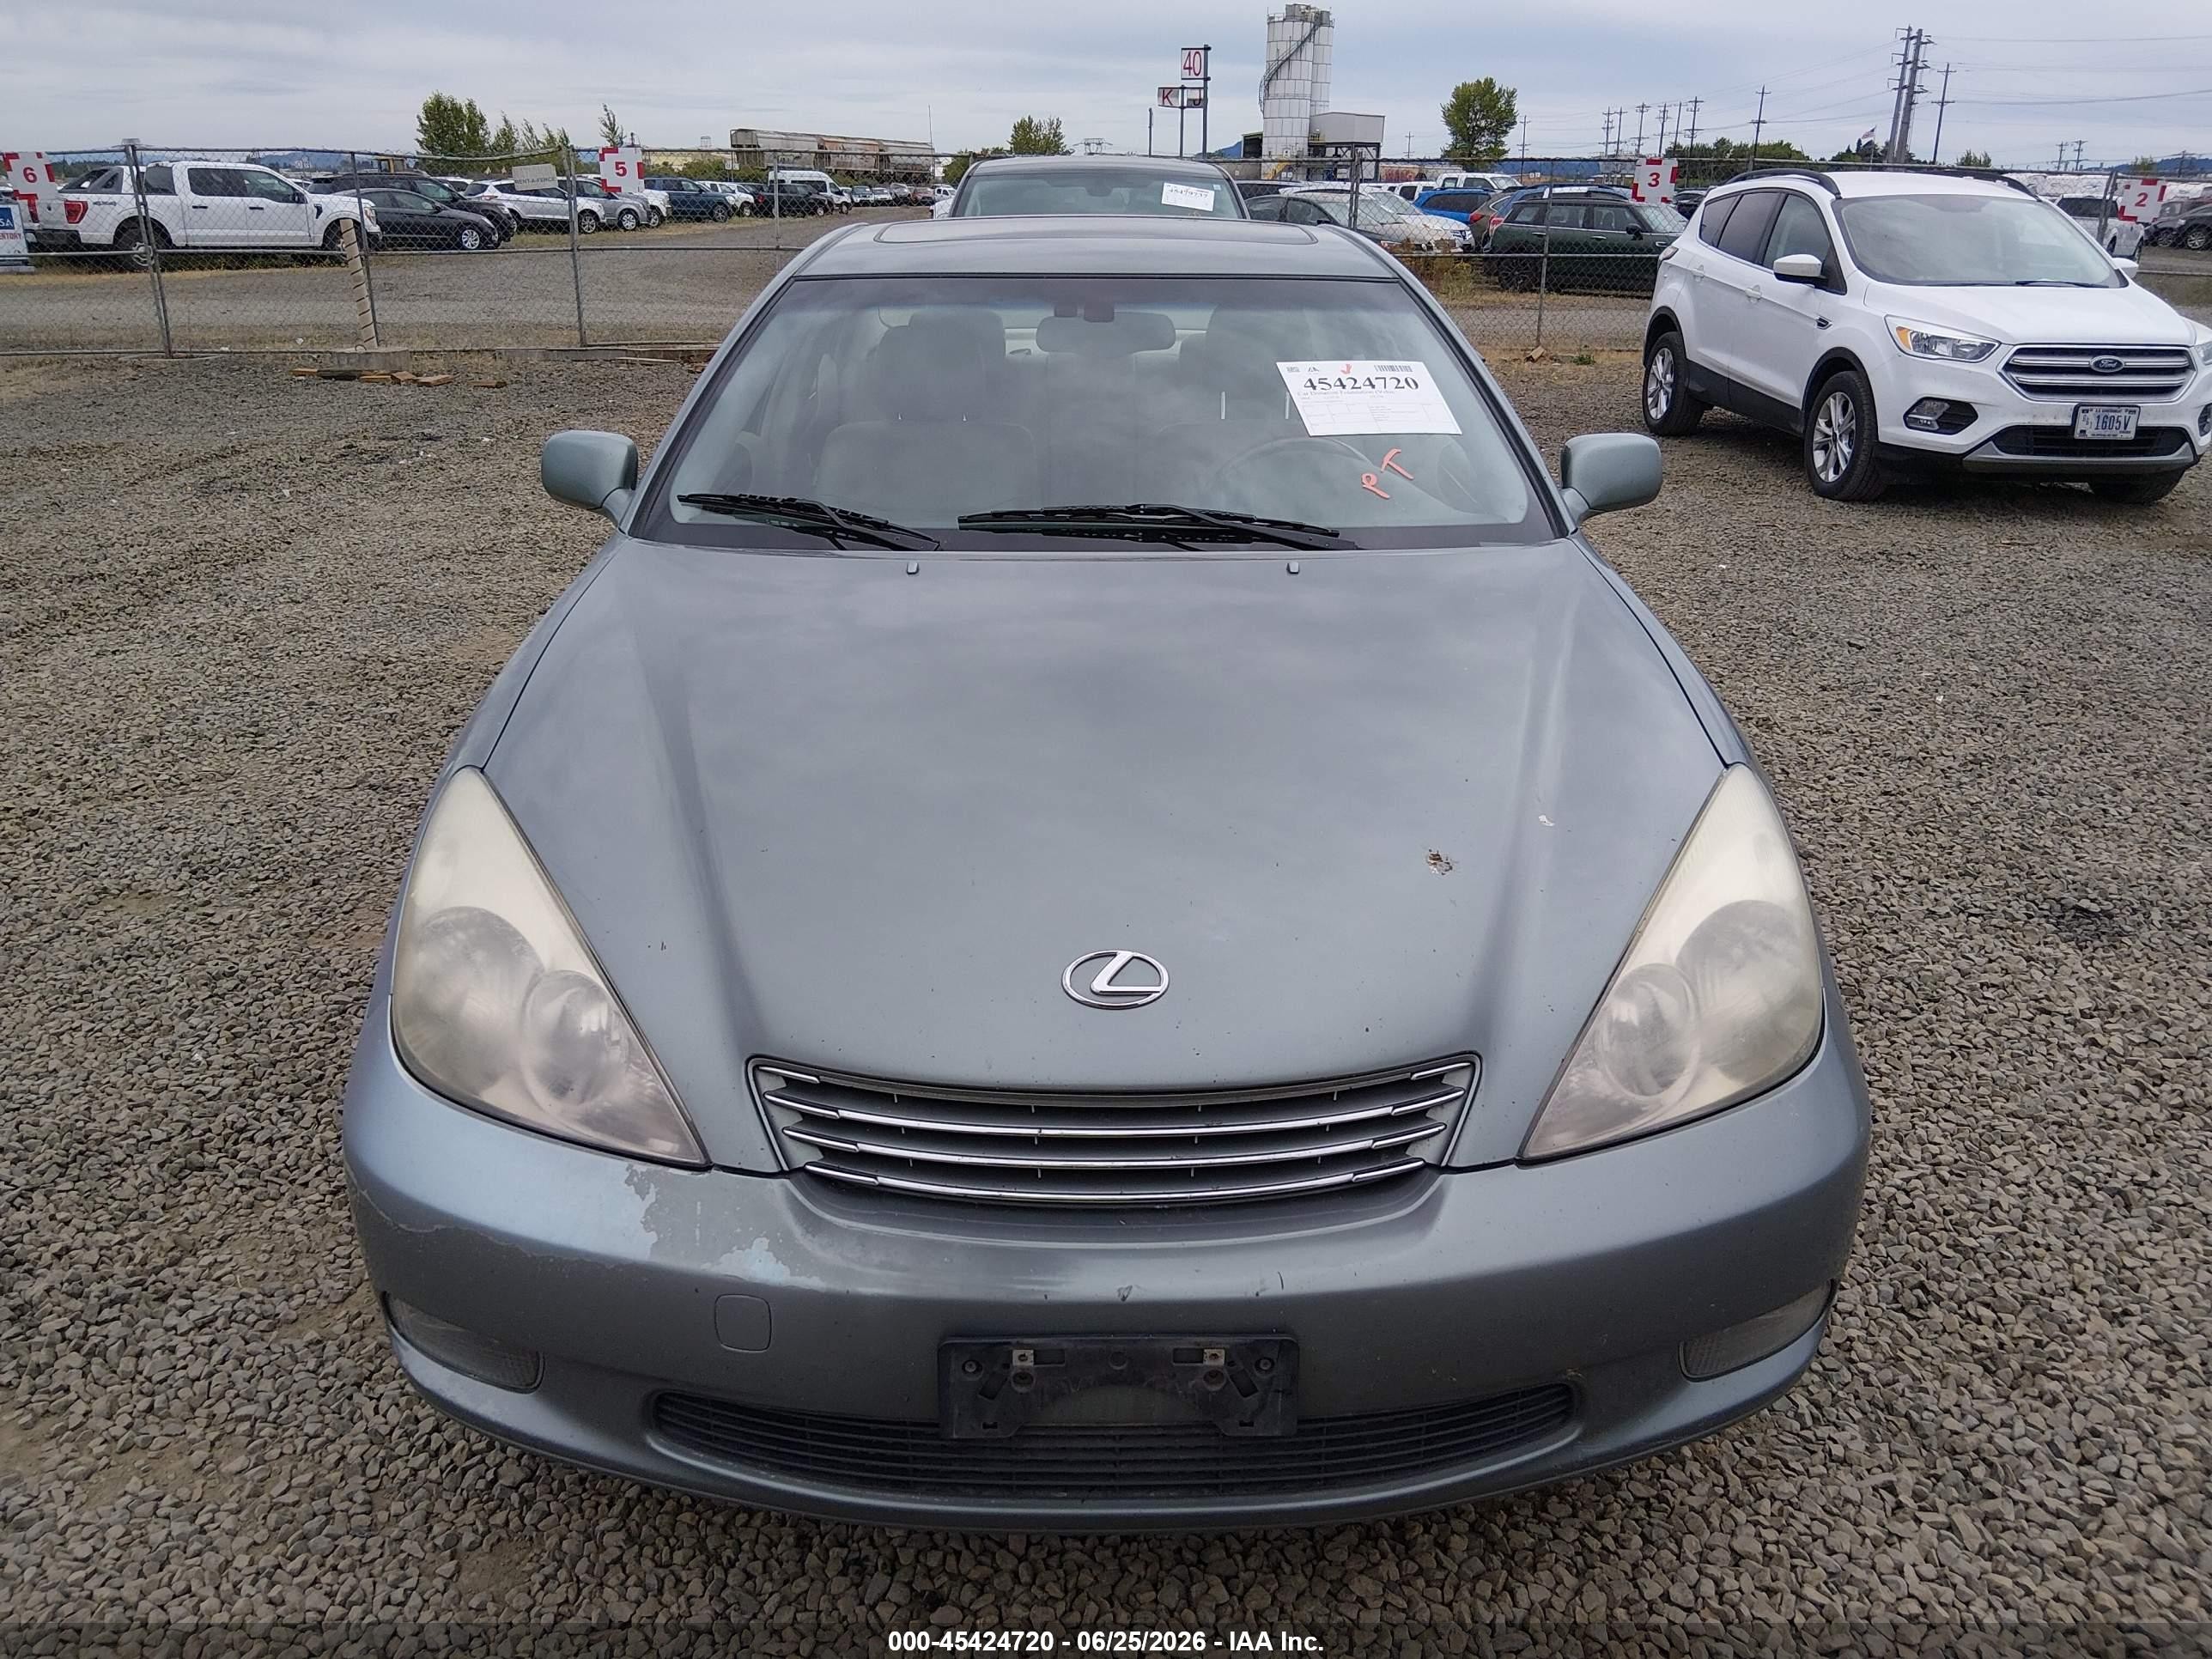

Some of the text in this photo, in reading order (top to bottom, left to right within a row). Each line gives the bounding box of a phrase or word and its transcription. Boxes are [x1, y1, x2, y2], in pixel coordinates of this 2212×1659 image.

[1183, 51, 1202, 76] 40
[1162, 89, 1173, 106] K
[1193, 89, 1201, 106] J
[23, 167, 38, 183] 6
[615, 161, 628, 177] 5
[1648, 172, 1661, 187] 3
[2135, 192, 2148, 207] 2
[0, 218, 13, 228] SA
[2100, 359, 2118, 368] Ford
[1304, 376, 1419, 391] 45424720
[2094, 414, 2131, 430] 1605V
